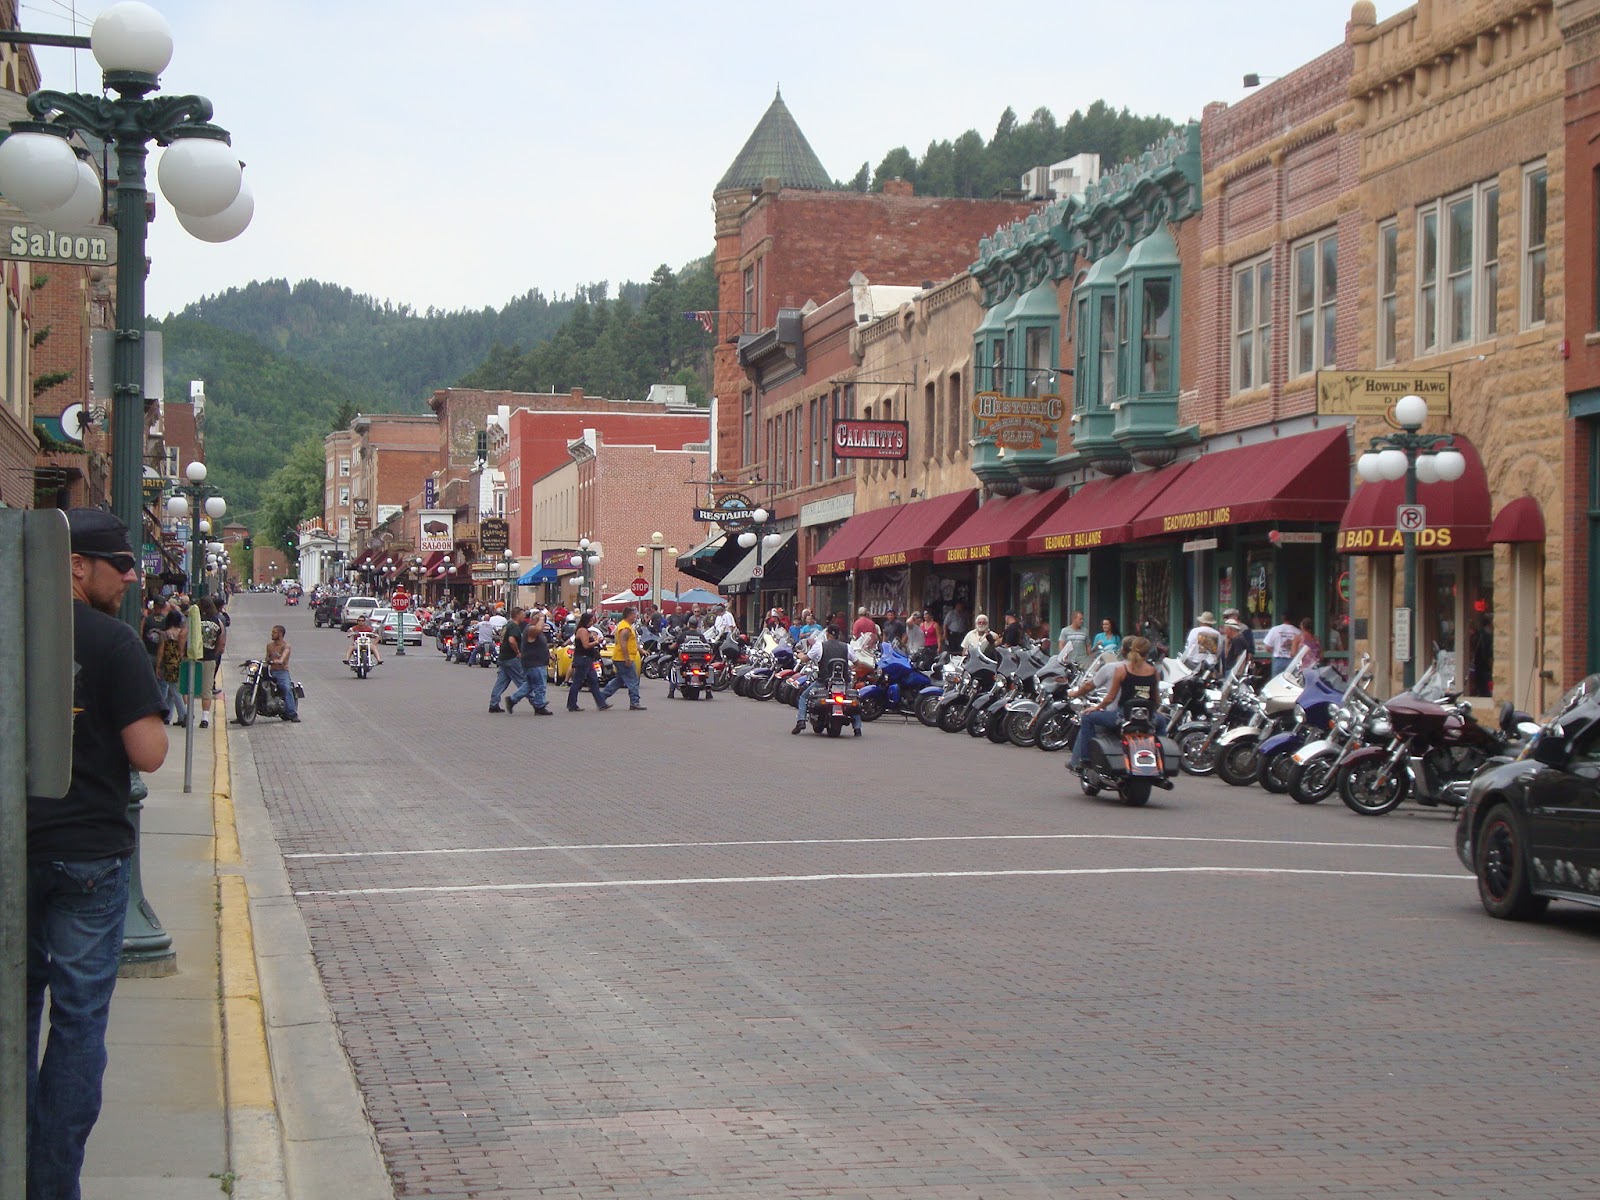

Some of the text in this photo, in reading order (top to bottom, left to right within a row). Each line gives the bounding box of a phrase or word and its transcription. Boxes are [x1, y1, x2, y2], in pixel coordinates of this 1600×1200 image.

[10, 225, 108, 261] Saloon
[1366, 379, 1446, 392] HOWLIN' HAWG
[978, 396, 1062, 419] HISTORIC
[837, 424, 903, 448] CALAMITY'S
[1003, 430, 1034, 443] CLUB
[1164, 507, 1230, 531] DEADWOOD BAD LANDS
[422, 541, 452, 550] SALOON
[1045, 531, 1102, 550] DEADWOOD BAD LANDS
[1346, 529, 1374, 548] BAD
[947, 548, 968, 561] DEADWOOD
[979, 545, 990, 558] LANDS
[632, 582, 649, 592] STOP
[392, 598, 409, 606] STOP
